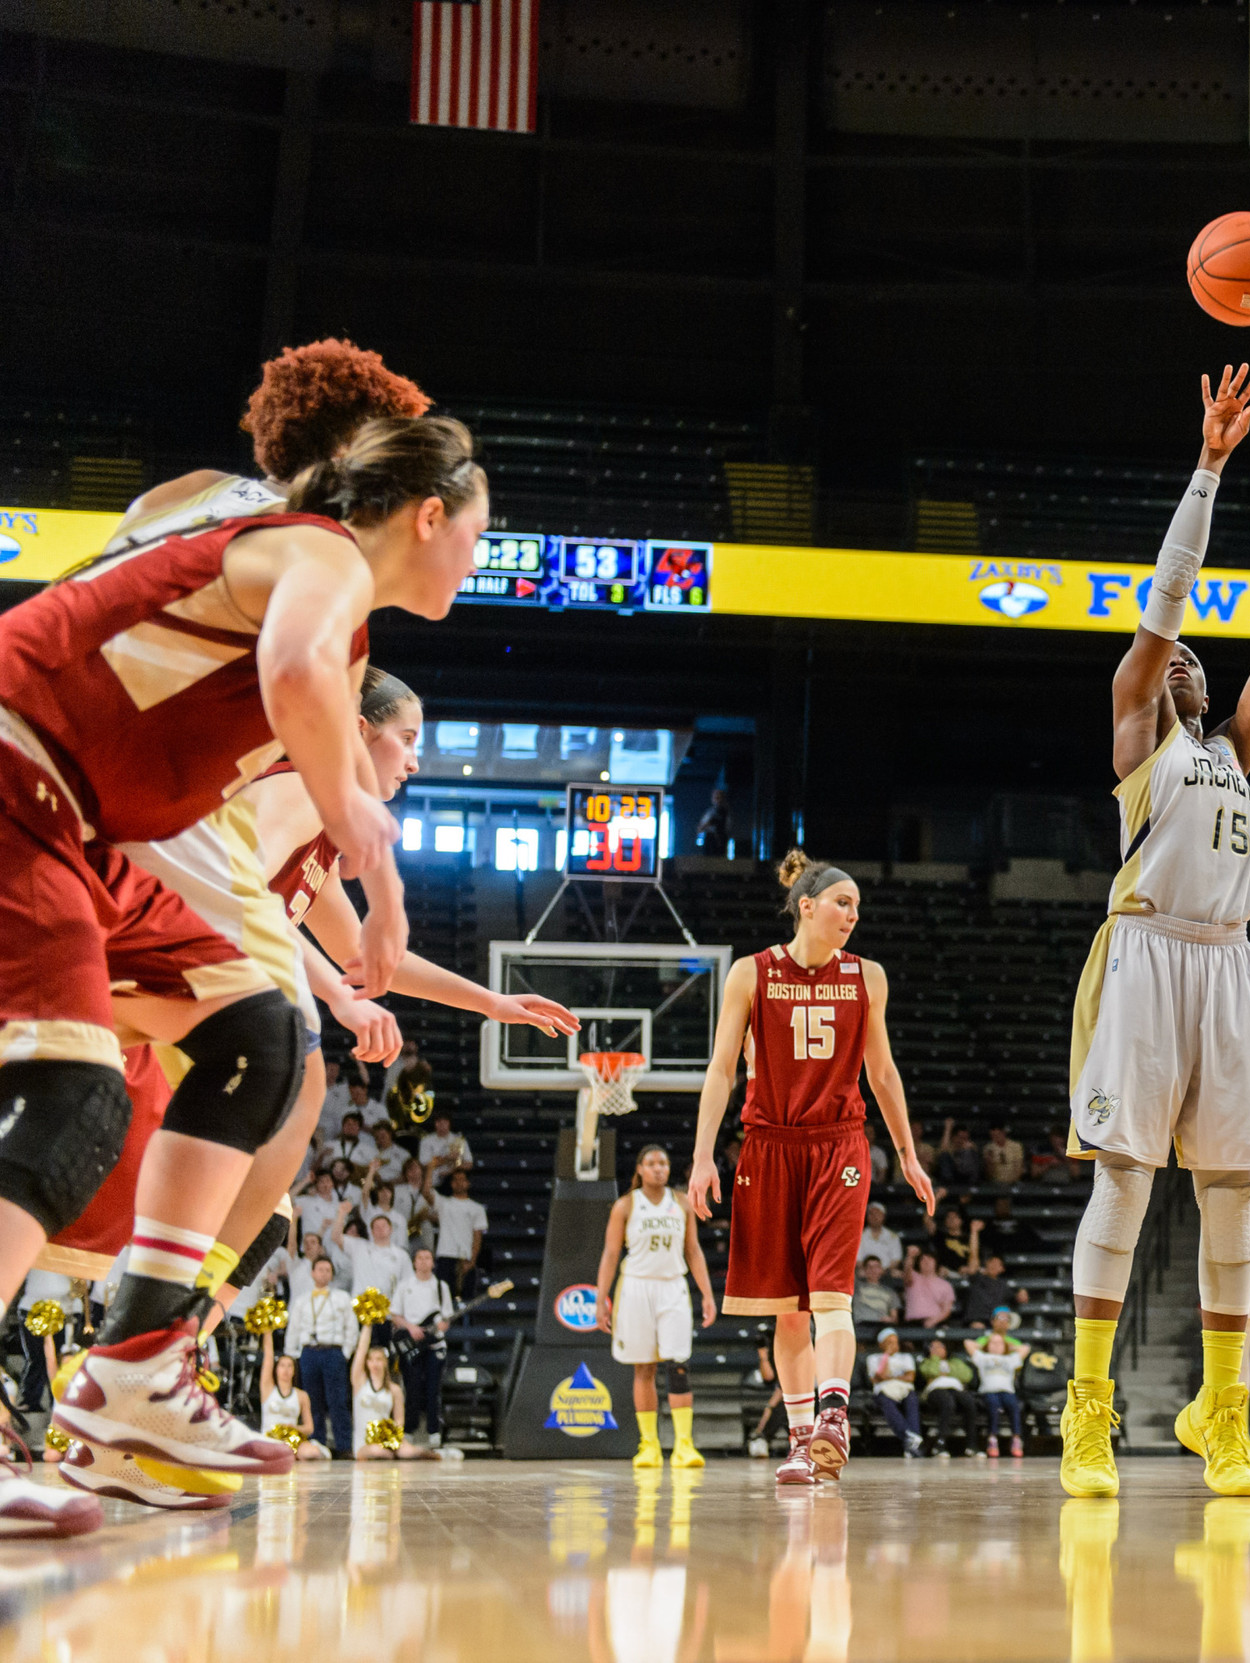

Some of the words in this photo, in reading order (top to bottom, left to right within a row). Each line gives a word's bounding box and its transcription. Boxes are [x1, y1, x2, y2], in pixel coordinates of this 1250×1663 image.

[574, 545, 619, 579] 53
[969, 560, 1063, 586] ZAXBY'S
[1211, 805, 1250, 858] 15
[767, 982, 811, 1001] BOSTON
[815, 983, 859, 1001] COLLEGE
[790, 1005, 836, 1060] 15
[650, 1234, 673, 1252] 54
